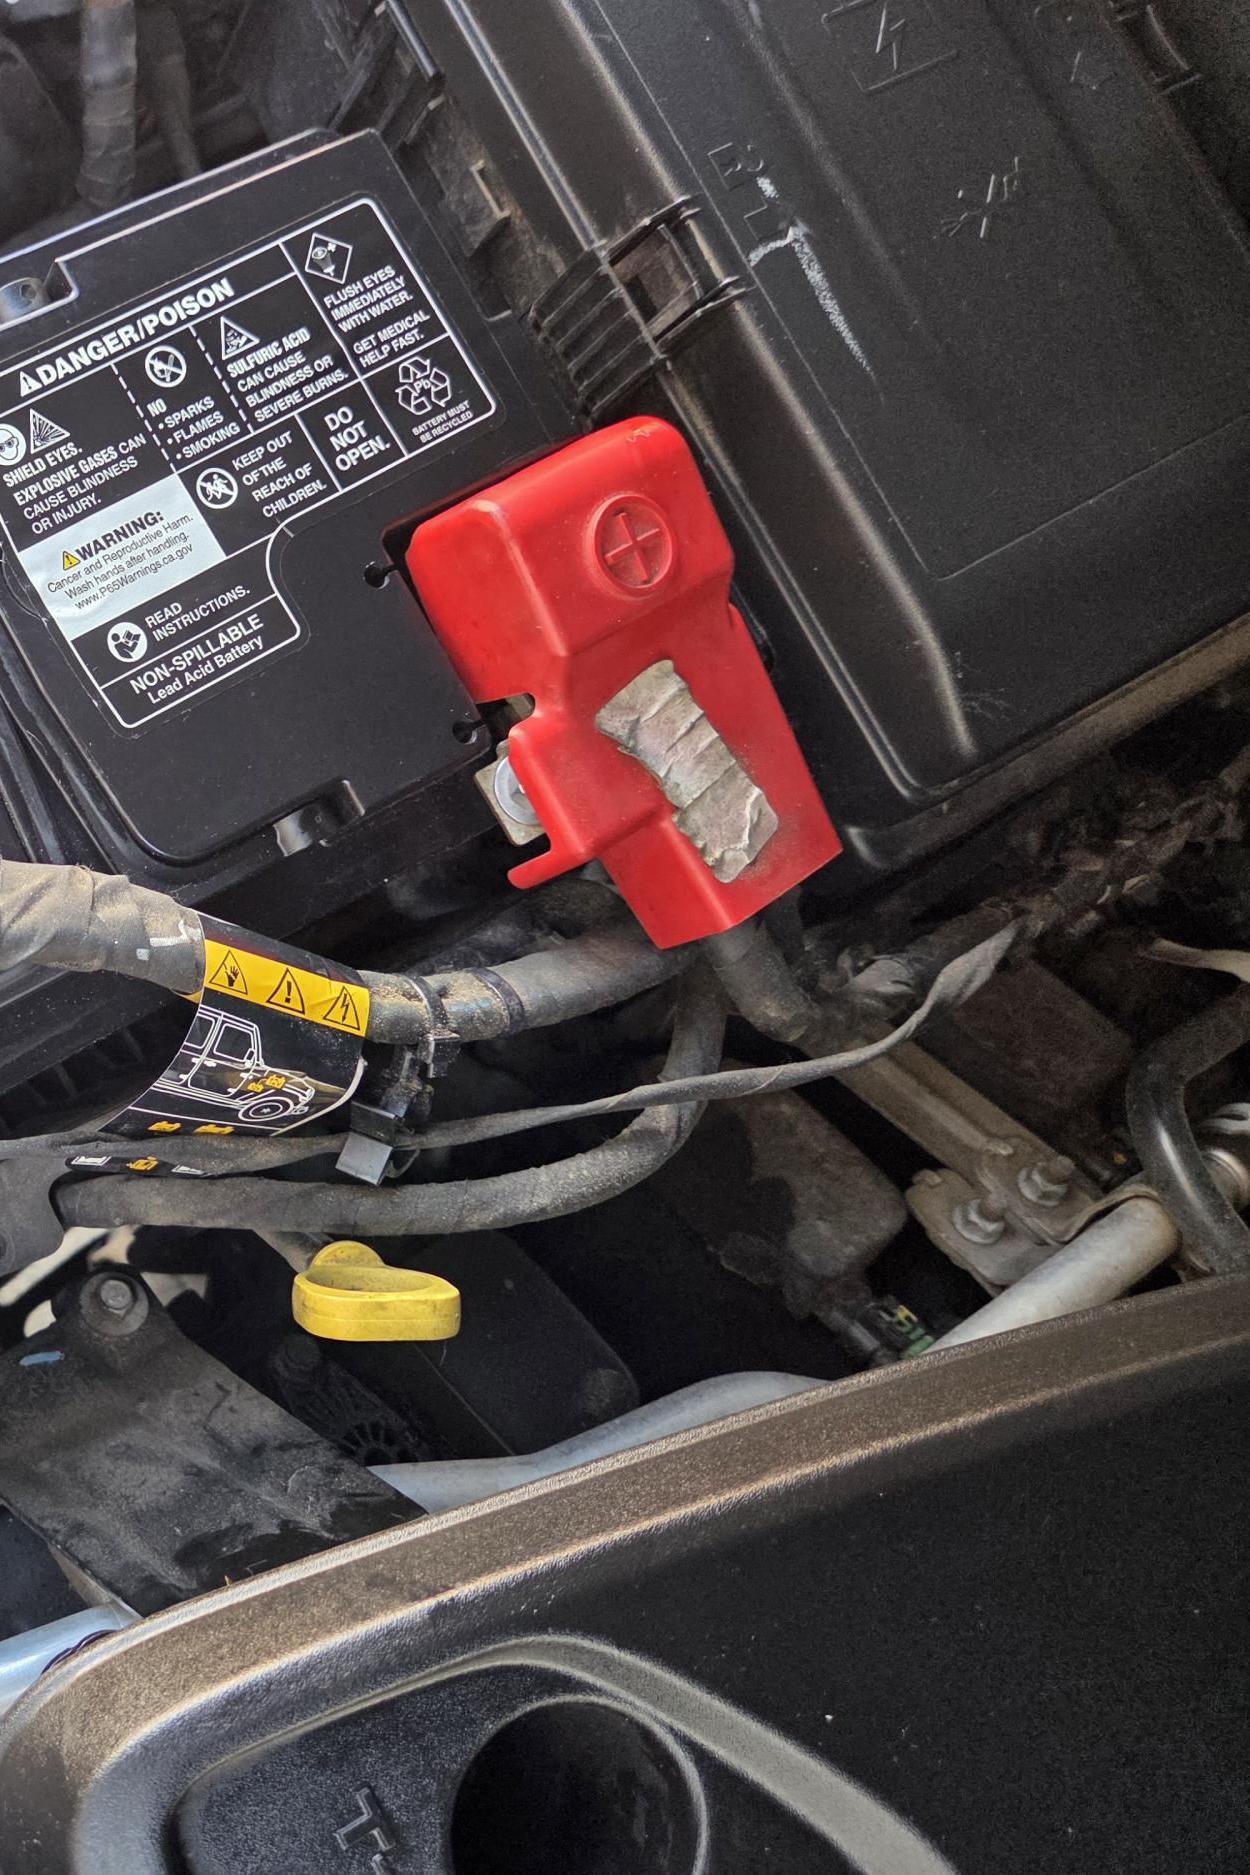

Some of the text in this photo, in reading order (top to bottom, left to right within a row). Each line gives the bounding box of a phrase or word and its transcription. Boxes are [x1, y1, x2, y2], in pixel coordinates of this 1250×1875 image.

[323, 265, 395, 308] FLUSH EYES
[330, 275, 404, 320] IMMEDIATELY
[35, 277, 234, 385] DANGER/POISON
[337, 290, 413, 332] WITH WATER.
[353, 309, 430, 353] GET MEDICAL
[226, 327, 310, 377] SULFURIC ACID
[359, 328, 424, 367] HELP FAST.
[237, 350, 305, 391] CAN CAUSE
[245, 354, 333, 407] BLINDNESS OR
[413, 378, 433, 395] Pb
[146, 398, 166, 417] NO
[164, 396, 214, 427] SPARKS
[254, 368, 348, 421] SEVERE BURNS.
[172, 410, 223, 443] FLAMES
[324, 406, 352, 431] DO
[329, 420, 366, 451] NOT
[412, 400, 469, 435] BATTERY MUST
[419, 410, 473, 442] BE RECYCLED
[182, 422, 240, 457] SMOKING
[231, 430, 292, 470] KEEP OUT
[335, 435, 390, 470] OPEN.
[2, 441, 82, 486] SHIELD EYES.
[13, 432, 146, 505] EXPLOSIVE GASES CAN
[242, 456, 286, 485] OF THE
[251, 462, 311, 501] REACH OF
[23, 455, 137, 519] CAUSE BLINDNESS
[262, 479, 326, 517] CHILDREN.
[31, 492, 101, 534] OR INJURY.
[47, 514, 193, 592] Cancer and Reproductive Harm.
[74, 511, 163, 562] WARNING:
[64, 531, 189, 599] Wash hands after handling.
[74, 543, 192, 609] www.P65Warnings.ca.gov
[144, 602, 182, 628] READ
[152, 585, 250, 641] INSTRUCTIONS.
[129, 613, 263, 694] NON-SPILLABLE
[147, 635, 262, 703] Lead Acid Battery
